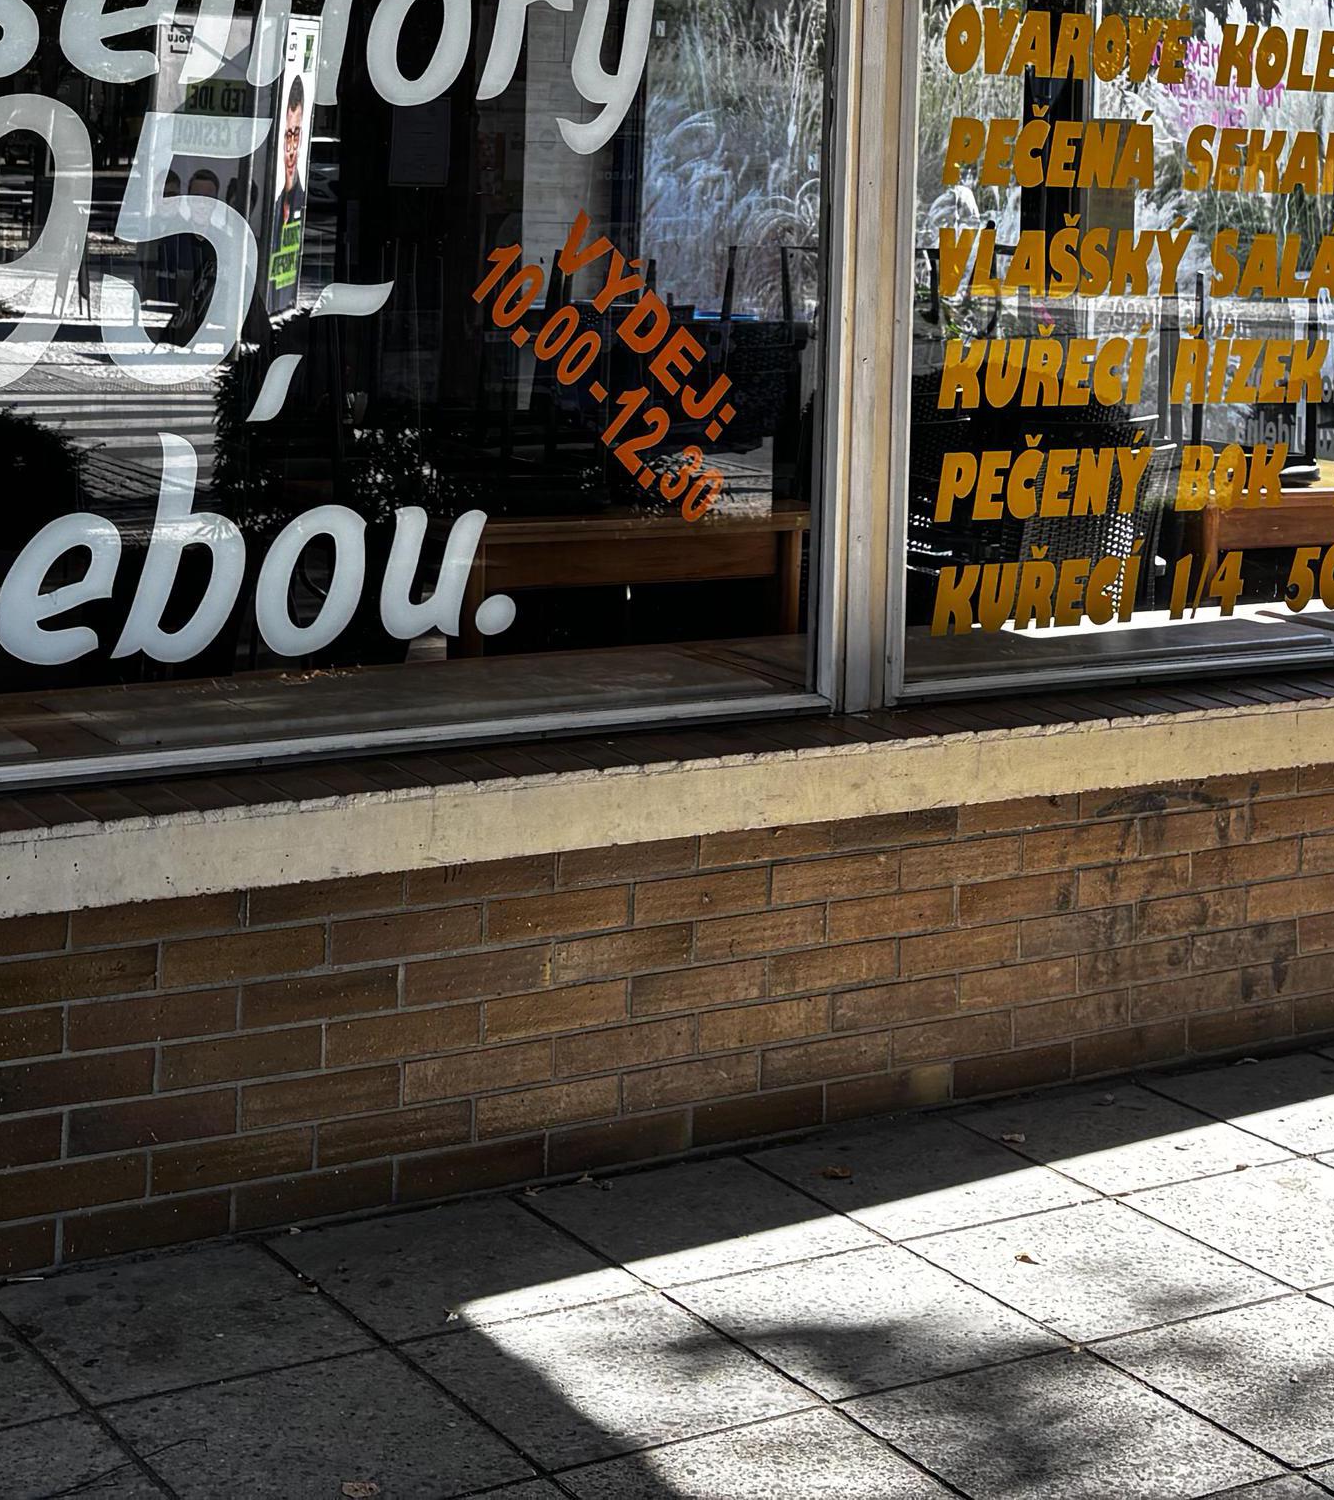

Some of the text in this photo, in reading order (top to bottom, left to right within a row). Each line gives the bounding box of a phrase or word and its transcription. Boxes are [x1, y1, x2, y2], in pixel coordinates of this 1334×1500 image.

[944, 3, 1192, 85] OVAROVÉ
[941, 104, 1156, 190] PEČENÁ
[938, 213, 1192, 299] VLAŠSKÝ
[557, 208, 737, 442] VÝDEJ:
[937, 323, 1150, 410] KUŘECÍ
[1170, 323, 1331, 405] ŘÍZEK
[933, 430, 1155, 524] PEČENÝ
[1174, 442, 1290, 512] BOK
[930, 539, 1145, 637] KUŘECÍ
[1167, 550, 1244, 620] 1/4
